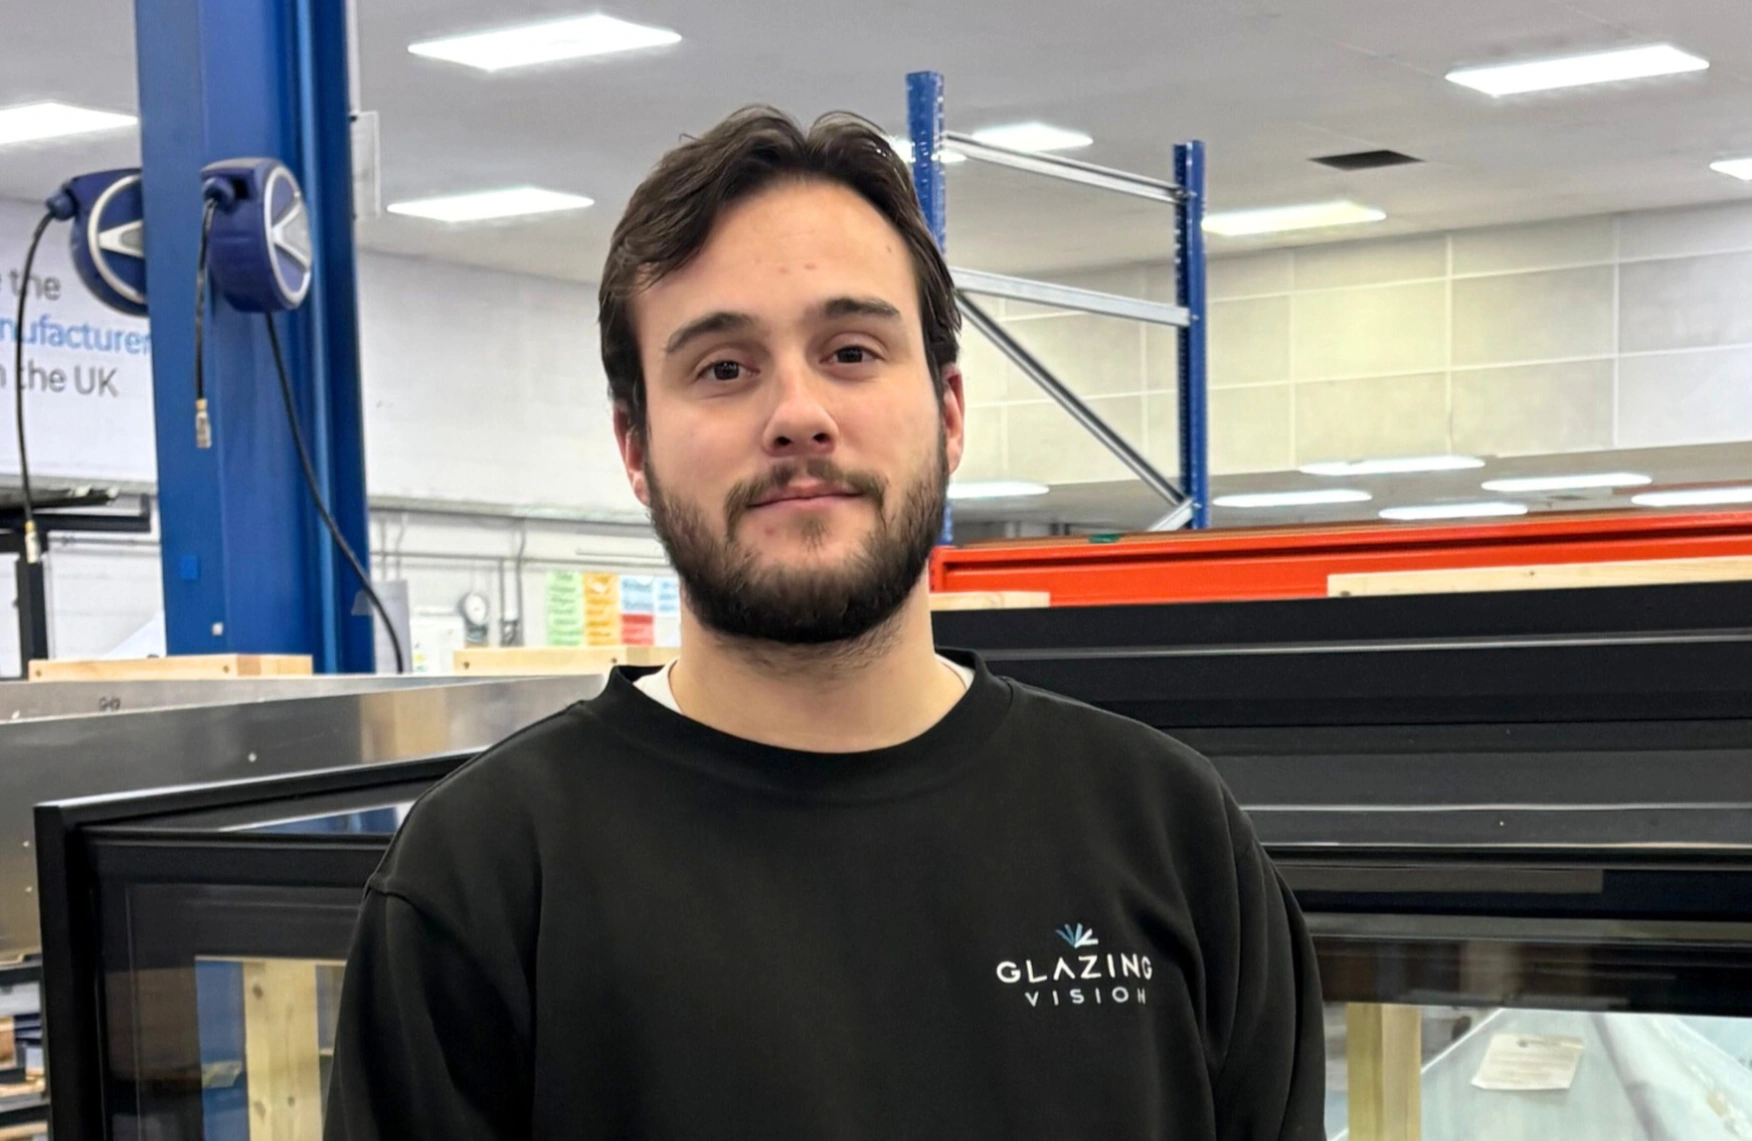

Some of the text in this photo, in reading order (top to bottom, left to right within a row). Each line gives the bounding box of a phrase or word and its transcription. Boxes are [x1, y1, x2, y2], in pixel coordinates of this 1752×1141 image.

[74, 365, 119, 398] UK
[996, 953, 1153, 984] GLAZING
[1024, 986, 1147, 1008] VISION
